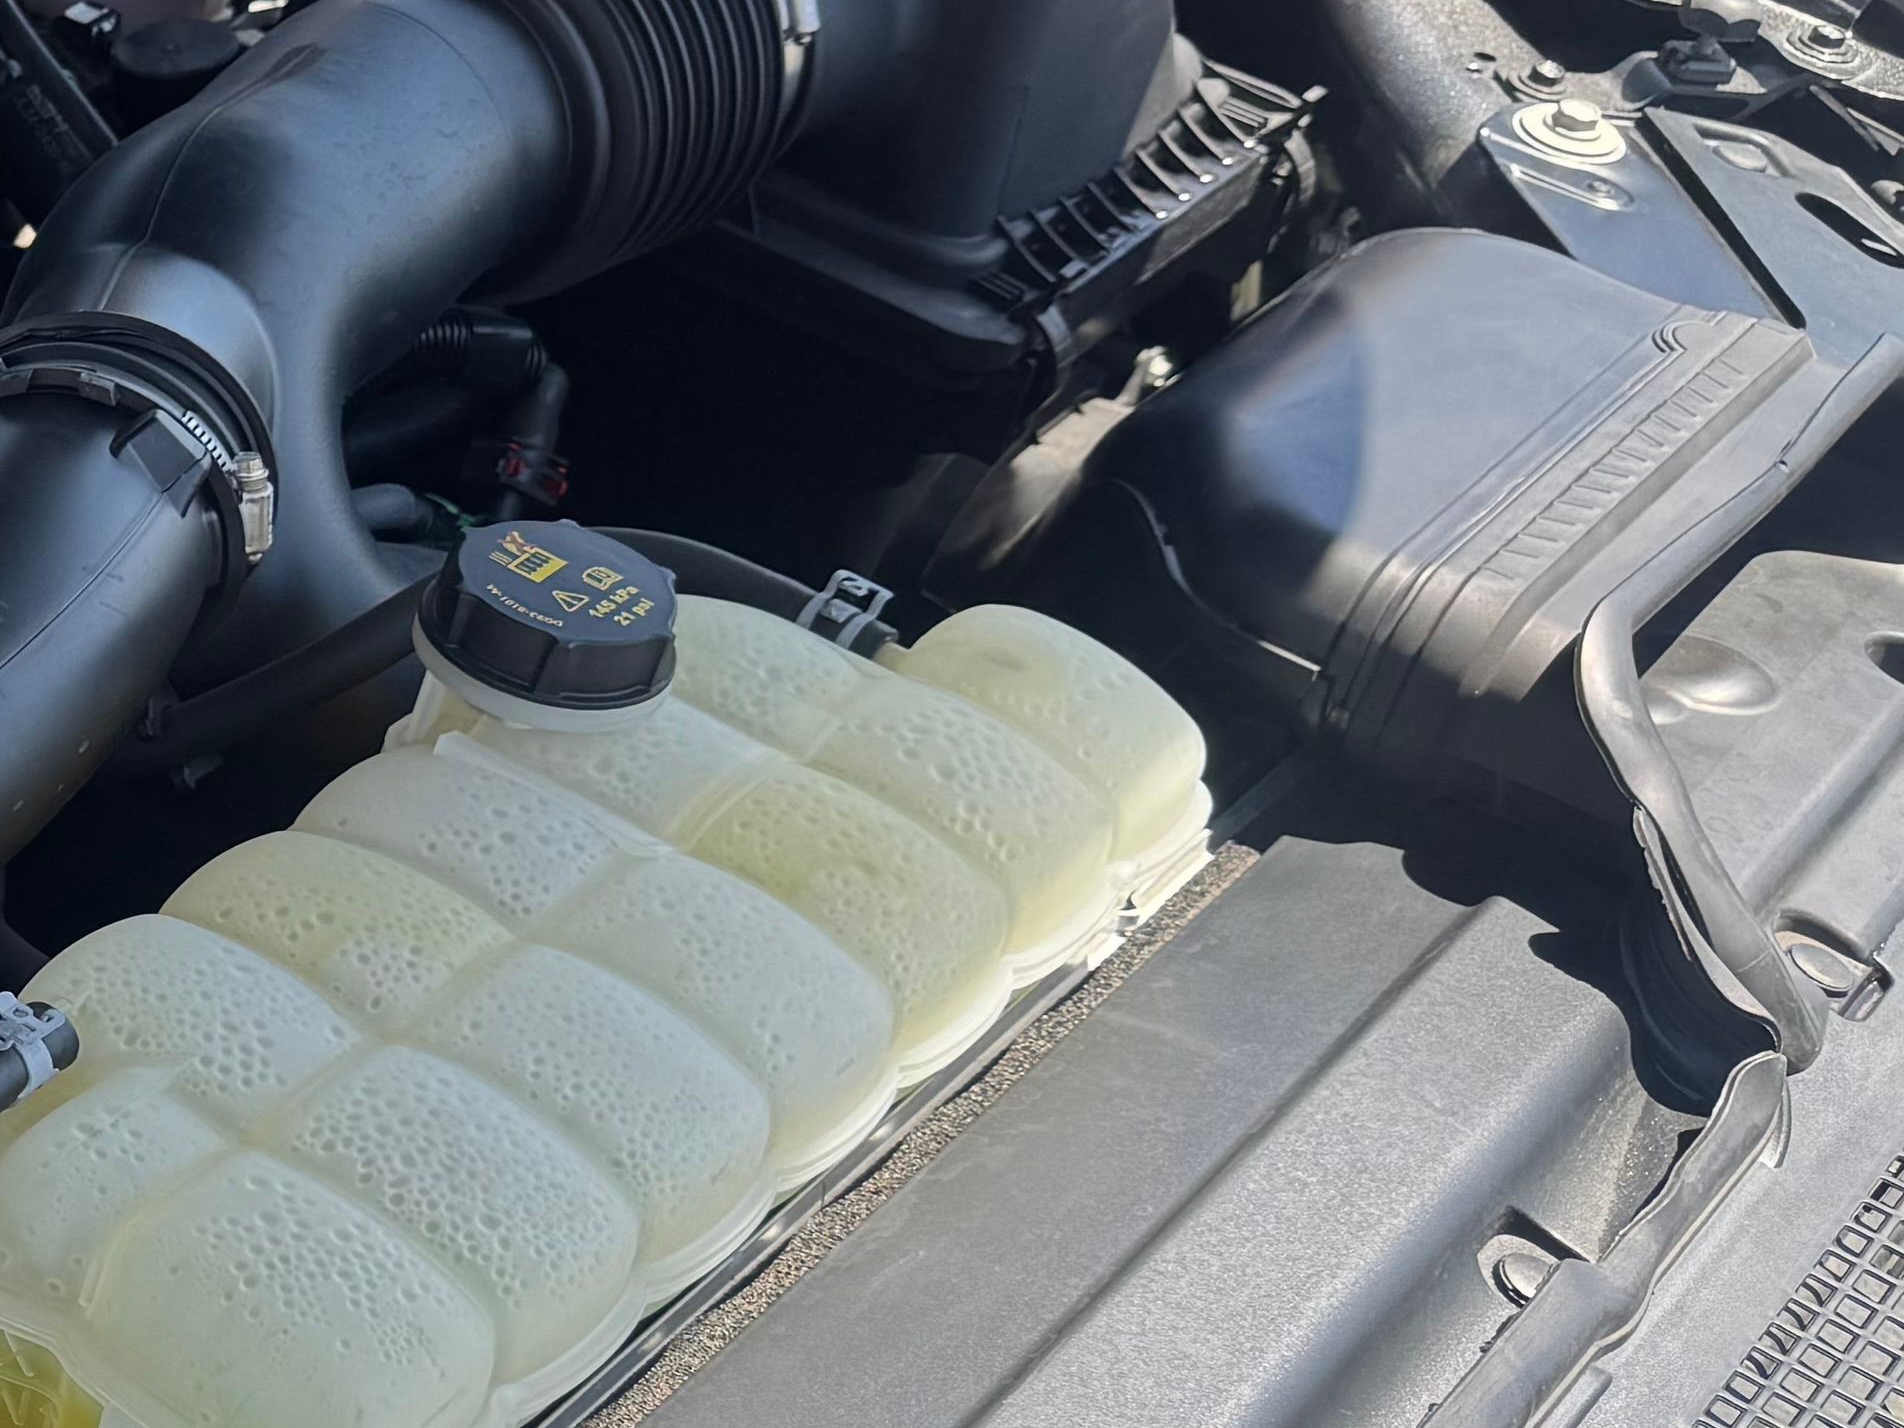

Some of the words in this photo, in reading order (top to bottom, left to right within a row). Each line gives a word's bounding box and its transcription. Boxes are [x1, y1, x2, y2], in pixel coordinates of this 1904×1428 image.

[589, 602, 612, 619] 145
[611, 585, 641, 606] kPa
[614, 613, 630, 626] 21
[630, 598, 654, 618] psi
